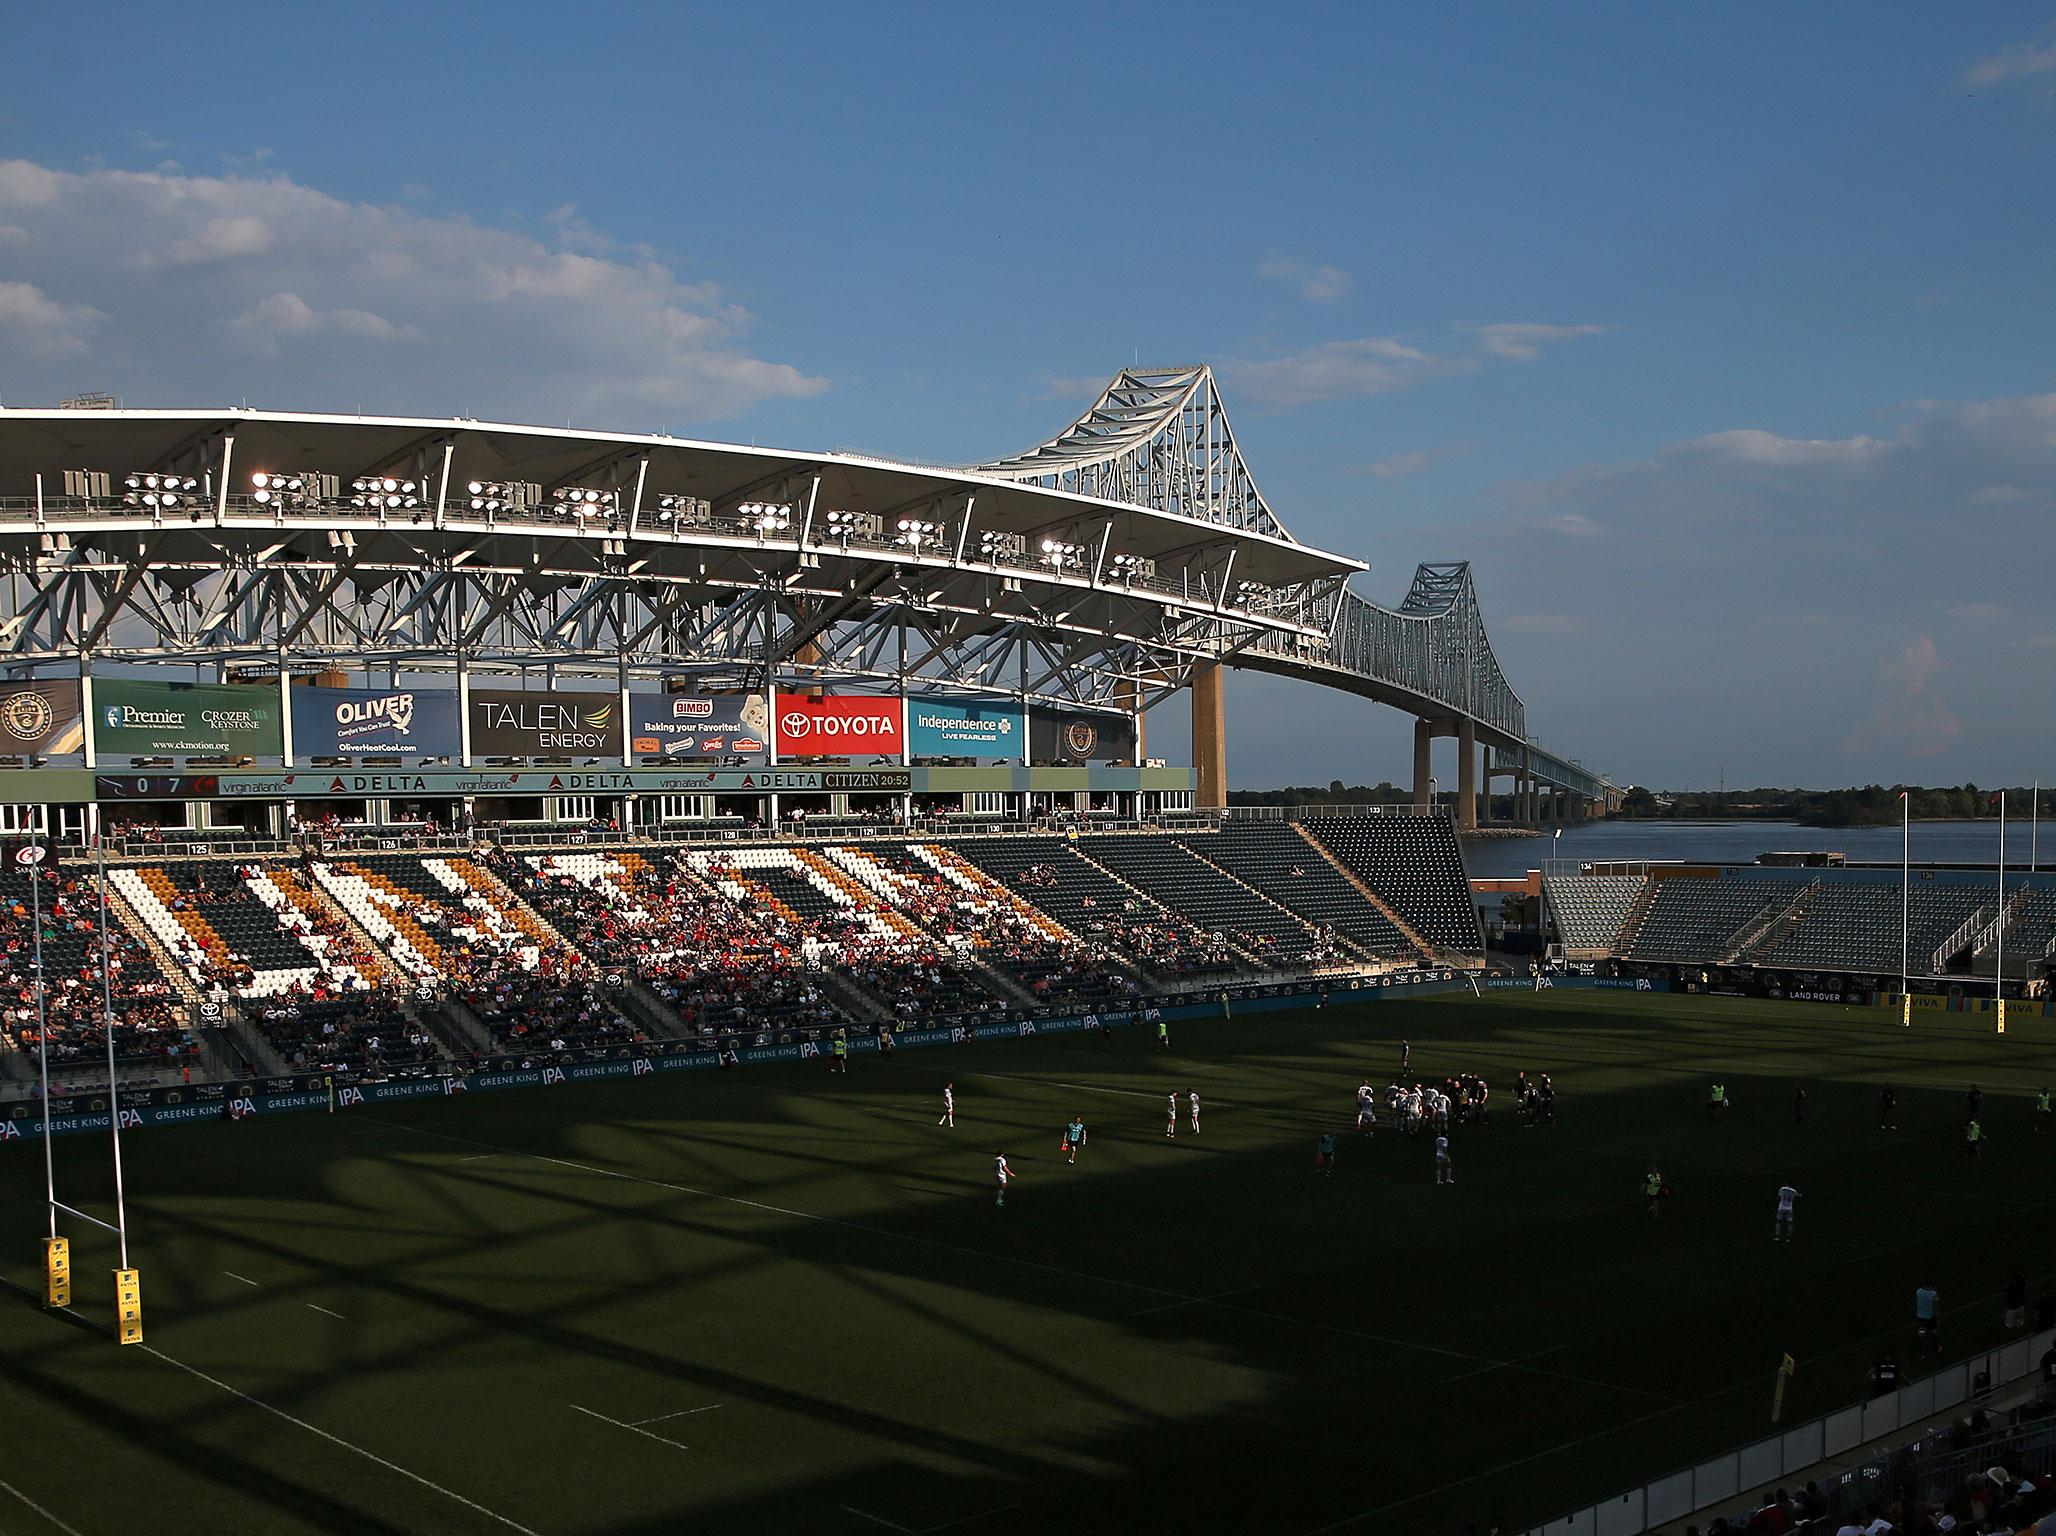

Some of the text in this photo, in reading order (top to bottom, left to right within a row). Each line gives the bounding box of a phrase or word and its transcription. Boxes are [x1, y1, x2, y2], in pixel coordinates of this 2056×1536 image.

[122, 706, 185, 724] Premier
[336, 694, 414, 724] OLIVER
[676, 703, 710, 713] BIMBO
[201, 710, 250, 722] CROZER
[478, 703, 578, 730] TALEN
[918, 714, 996, 732] Independence
[210, 720, 260, 729] KEYSTONE
[338, 721, 391, 737] Comfort You Can Trust
[644, 722, 741, 733] Baking your Favorites!
[812, 716, 895, 735] TOYOTA
[539, 733, 606, 748] ENERGY
[958, 734, 997, 742] FEARLESS
[152, 741, 230, 752] www.ckmotion.org
[338, 743, 417, 752] OliverHeatCool.com
[137, 778, 180, 793] 0 7
[354, 776, 426, 791] DELTA
[570, 775, 634, 788] DELTA
[761, 774, 817, 787] DELTA
[825, 773, 909, 787] CITIZEN 20:52
[724, 831, 736, 839] 128
[863, 828, 873, 836] 129
[989, 824, 1000, 833] 130
[381, 840, 396, 849] 126
[571, 836, 584, 844] 127
[191, 844, 208, 854] 125
[1516, 979, 1532, 987] KING
[1539, 977, 1553, 989] PA
[1594, 979, 1617, 987] GREENE
[1636, 979, 1652, 991] IPA
[1789, 991, 1840, 1001] LAND ROVER
[1145, 1008, 1161, 1020] IPA
[975, 1020, 1036, 1036] GREENE KING IPA
[1042, 1020, 1064, 1029] GREENE
[1083, 1014, 1099, 1029] IPA
[903, 1026, 966, 1043] GREENE KING IPA
[856, 1039, 875, 1049] KING
[877, 1034, 896, 1050] IA
[747, 1041, 820, 1060] GREENE KING IPA
[572, 1058, 654, 1078] GREENE KING IPA
[663, 1058, 693, 1068] GREENE
[695, 1055, 716, 1064] KING
[479, 1067, 566, 1086] GREENE KING IPA
[376, 1087, 412, 1097] GREENE
[415, 1083, 439, 1093] KING
[267, 1096, 306, 1109] GREENE
[338, 1086, 365, 1106] IPA
[155, 1097, 256, 1120] GREENE KING IPA
[34, 1108, 144, 1132] GEENE KING PA
[0, 1120, 21, 1141] PA
